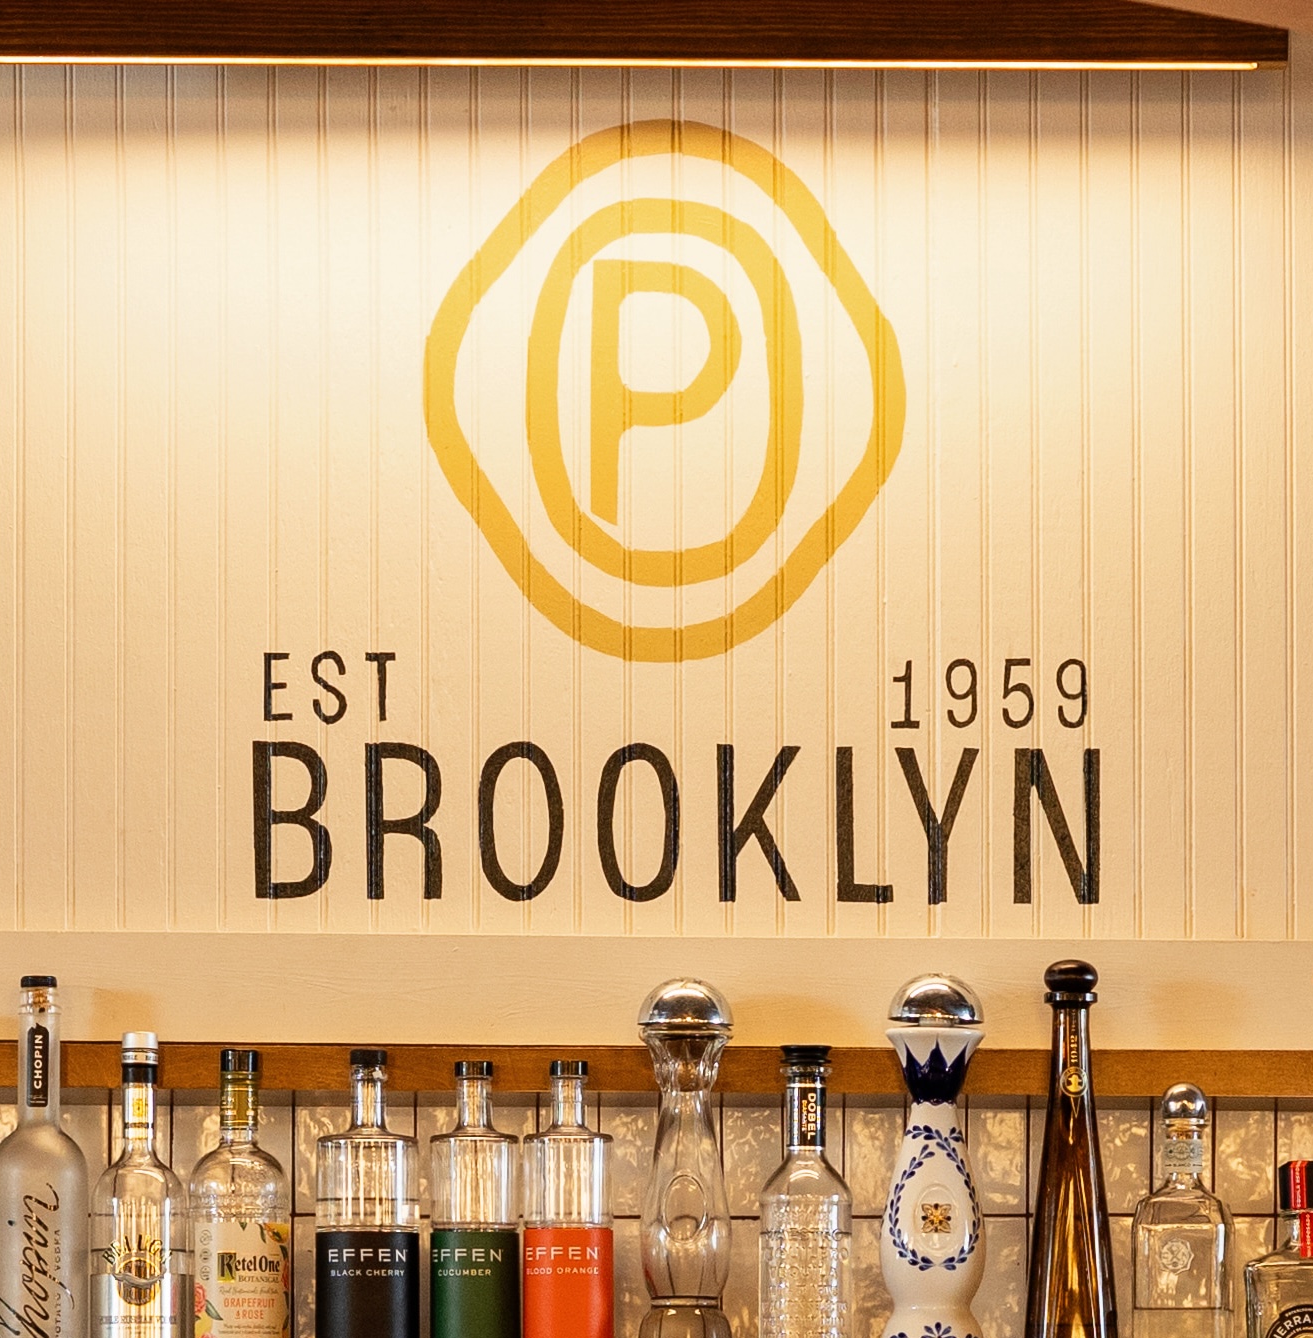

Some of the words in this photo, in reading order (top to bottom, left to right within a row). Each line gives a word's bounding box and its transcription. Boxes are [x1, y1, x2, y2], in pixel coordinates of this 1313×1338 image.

[262, 650, 397, 726] EST
[890, 657, 1090, 730] 1959
[251, 740, 1101, 906] BROOKLYN
[1070, 1035, 1078, 1063] 1942
[33, 1034, 44, 1090] CHOPIN
[807, 1092, 817, 1140] DOBEL
[328, 1248, 406, 1263] EFFEN
[432, 1248, 503, 1263] EFFEN
[526, 1246, 598, 1261] EFFEN
[220, 1254, 257, 1280] Ketel
[258, 1255, 280, 1273] One
[330, 1269, 363, 1277] BLACK
[366, 1269, 405, 1277] CHERRY
[437, 1269, 492, 1277] CUCUMBER
[526, 1267, 553, 1275] BLOOD
[556, 1267, 599, 1275] ORANGE
[223, 1298, 275, 1308] GRAPEFRUIT
[241, 1310, 264, 1320] ROSE
